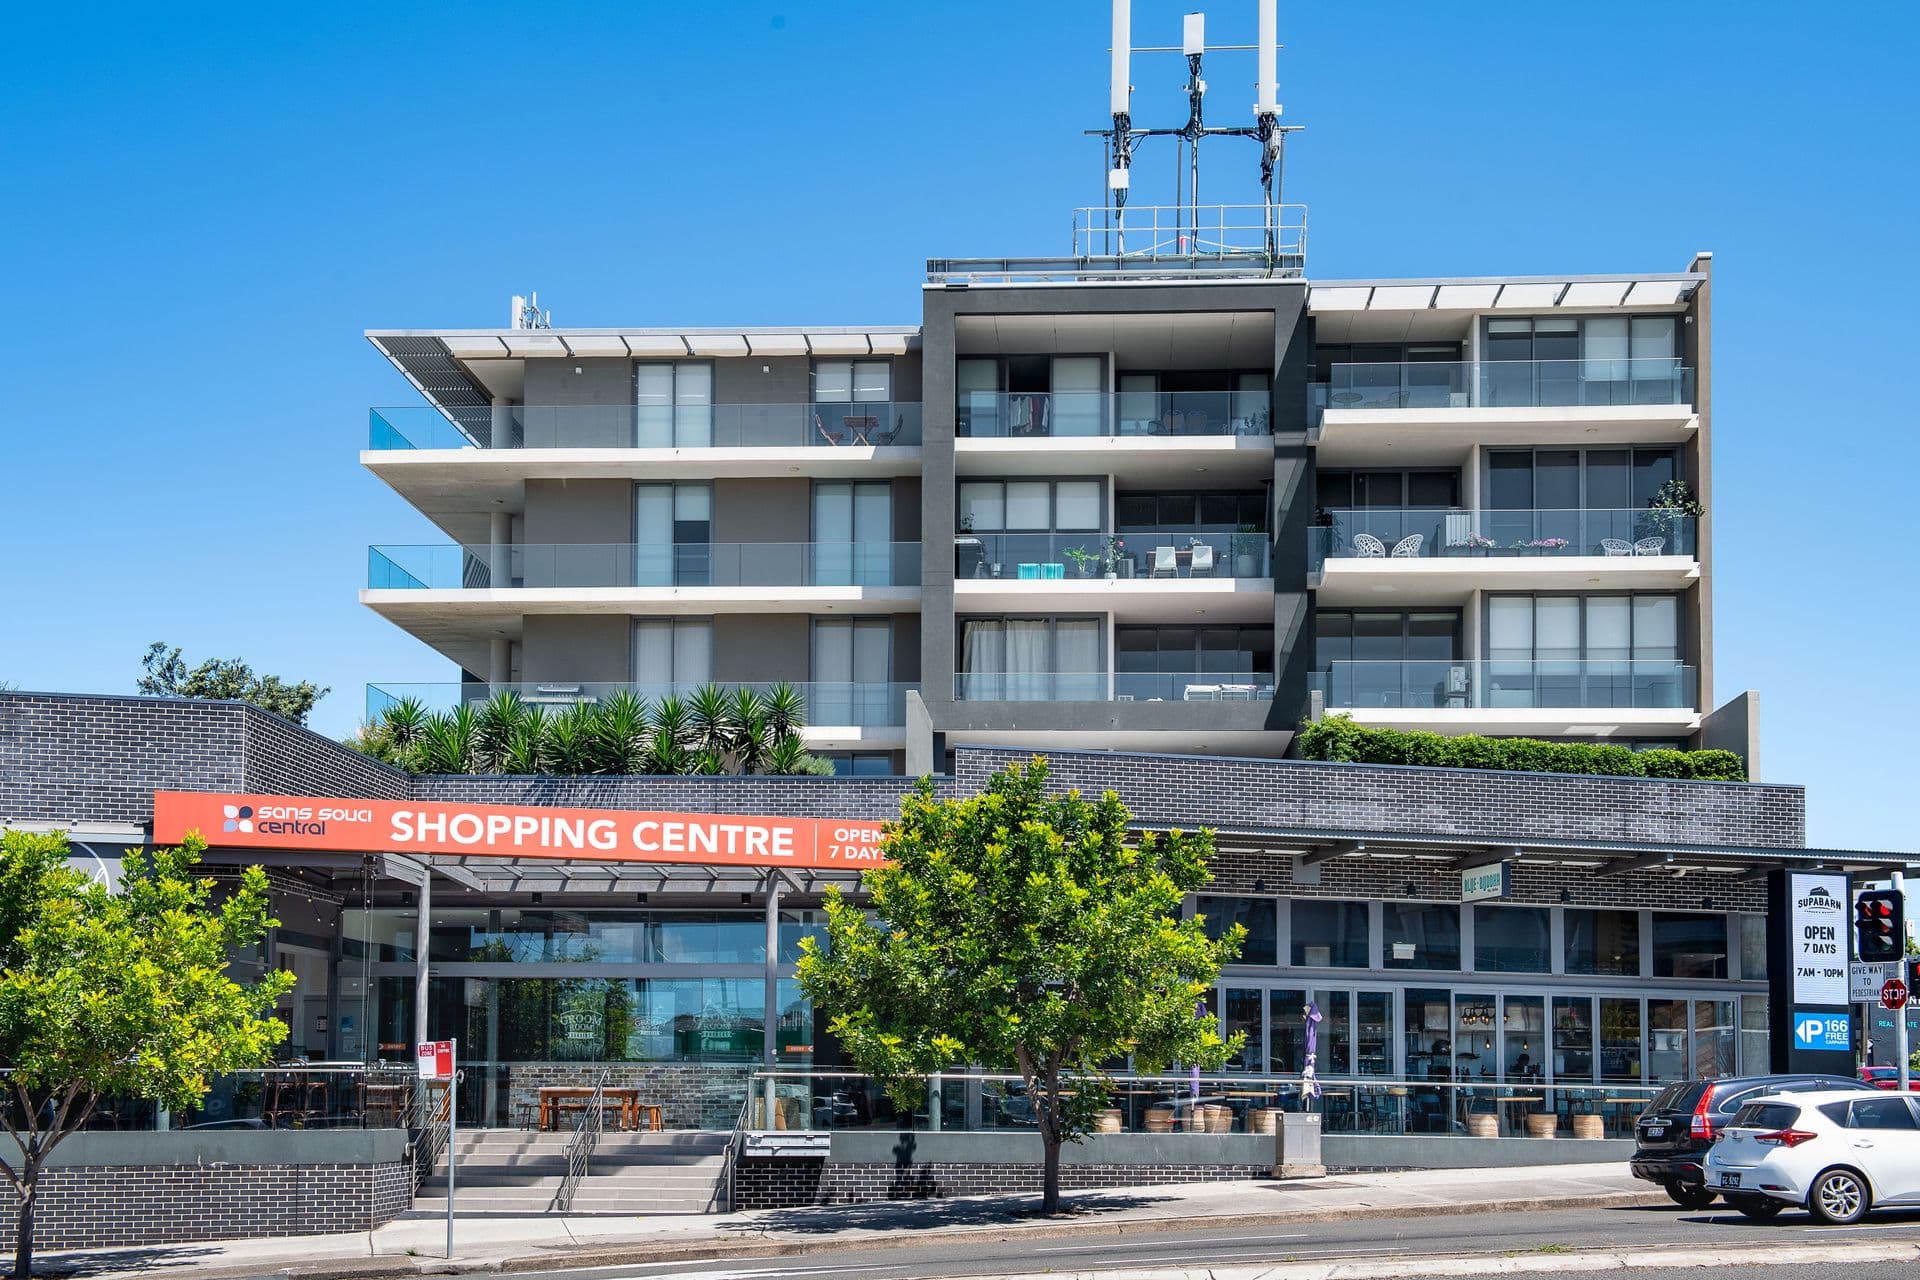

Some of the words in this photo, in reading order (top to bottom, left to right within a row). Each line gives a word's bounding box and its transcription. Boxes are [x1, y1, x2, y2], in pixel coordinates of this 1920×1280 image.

[258, 806, 312, 819] sans
[318, 808, 372, 822] souci
[258, 820, 325, 835] central
[390, 811, 617, 851] SHOPPING
[632, 821, 794, 857] CENTRE
[834, 828, 885, 843] OPEN
[828, 845, 839, 859] 7
[1798, 897, 1841, 910] SUPABARN
[1805, 926, 1834, 940] OPEN
[1804, 944, 1810, 953] 7
[1813, 944, 1836, 954] DAYS
[1797, 968, 1815, 977] 7AM
[1824, 969, 1843, 978] 10PM
[1852, 966, 1866, 975] GIVE
[1868, 966, 1882, 975] WAY
[1863, 978, 1871, 986] TO
[1852, 989, 1881, 998] PEDESTRIAN
[1883, 989, 1905, 1001] STOP
[560, 1014, 602, 1025] GROOM
[1878, 1020, 1894, 1028] REAL
[1825, 1020, 1848, 1032] 166
[1825, 1032, 1848, 1041] FREE
